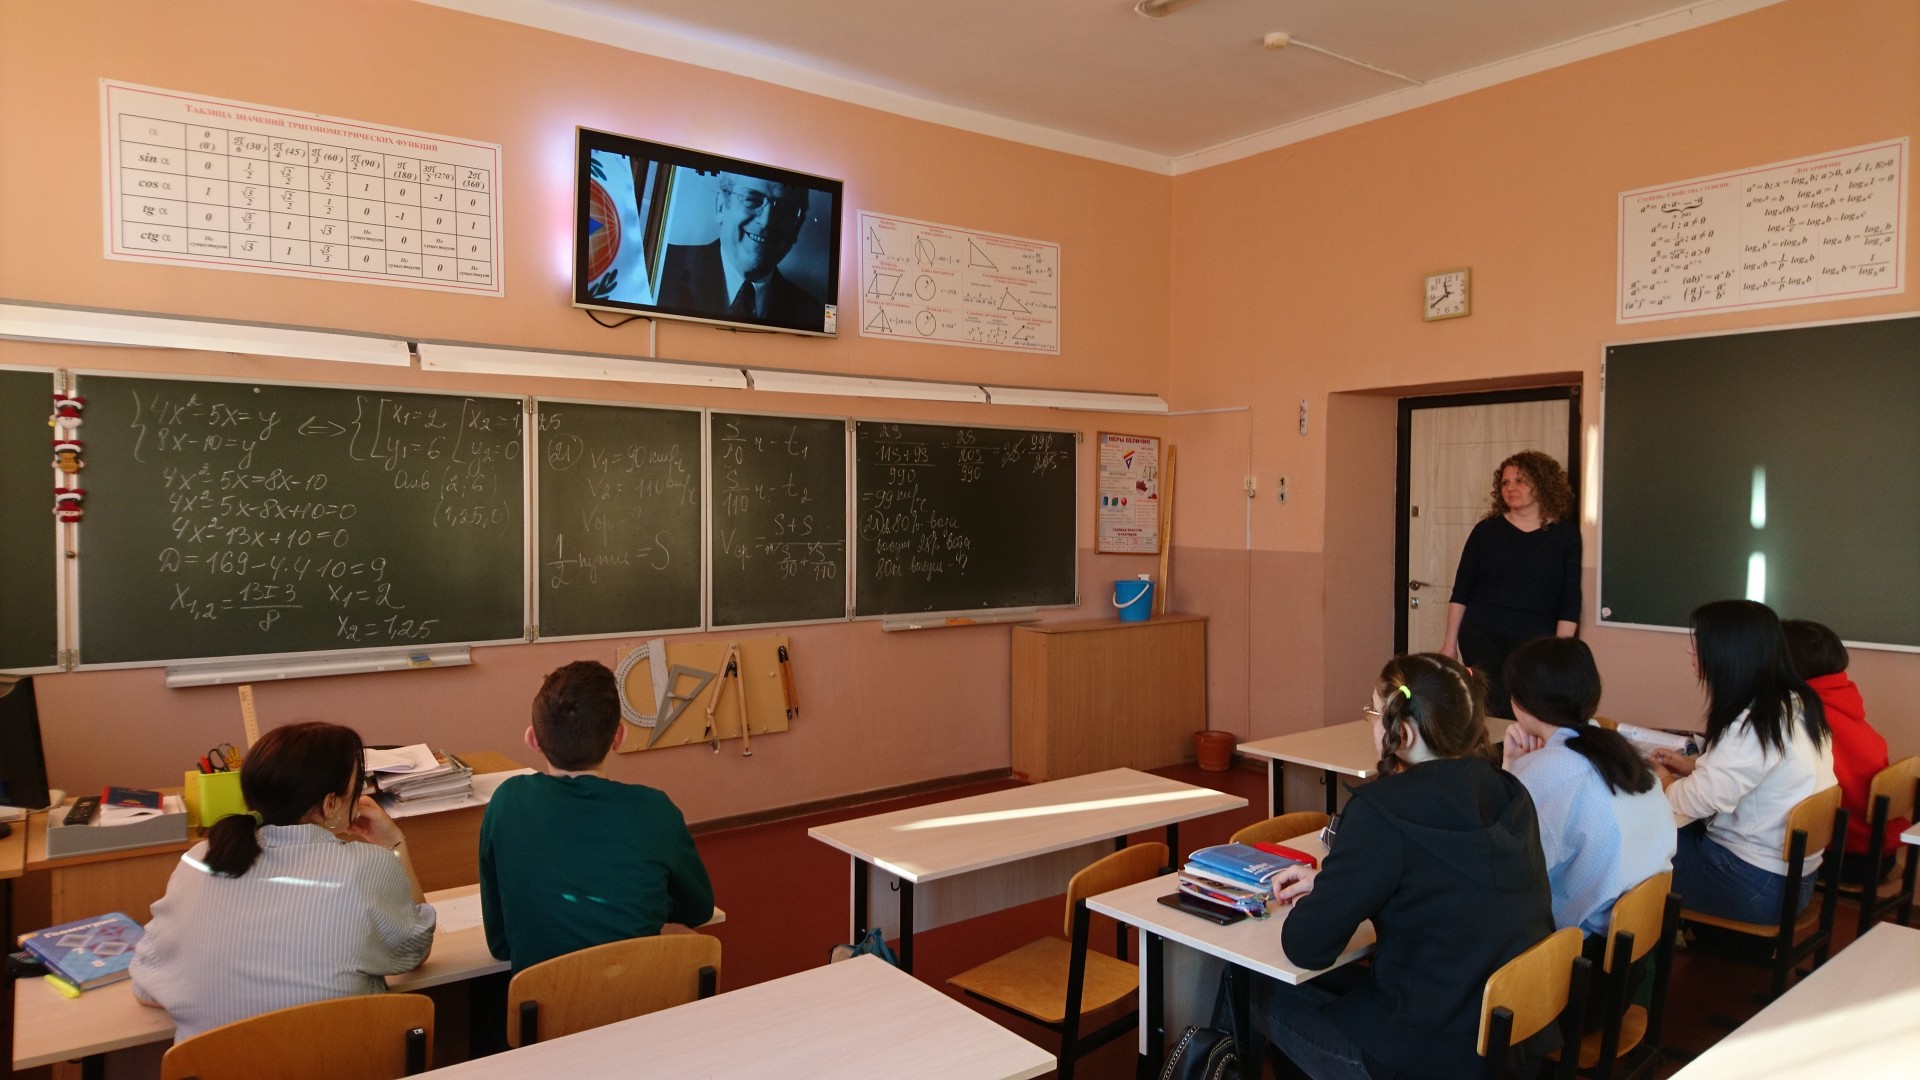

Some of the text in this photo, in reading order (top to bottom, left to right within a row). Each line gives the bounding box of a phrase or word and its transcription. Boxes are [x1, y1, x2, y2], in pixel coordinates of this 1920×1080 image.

[138, 152, 158, 164] sin
[204, 161, 211, 170] 0
[138, 179, 159, 189] cos
[399, 188, 406, 196] 0
[470, 199, 476, 207] 0
[142, 204, 155, 216] tg
[363, 207, 370, 216] 0
[205, 213, 212, 222] 0
[436, 217, 442, 225] 0
[140, 231, 159, 242] ctg
[401, 236, 407, 244] 0
[471, 245, 477, 253] 0
[363, 255, 370, 263] 0
[437, 264, 443, 272] 0
